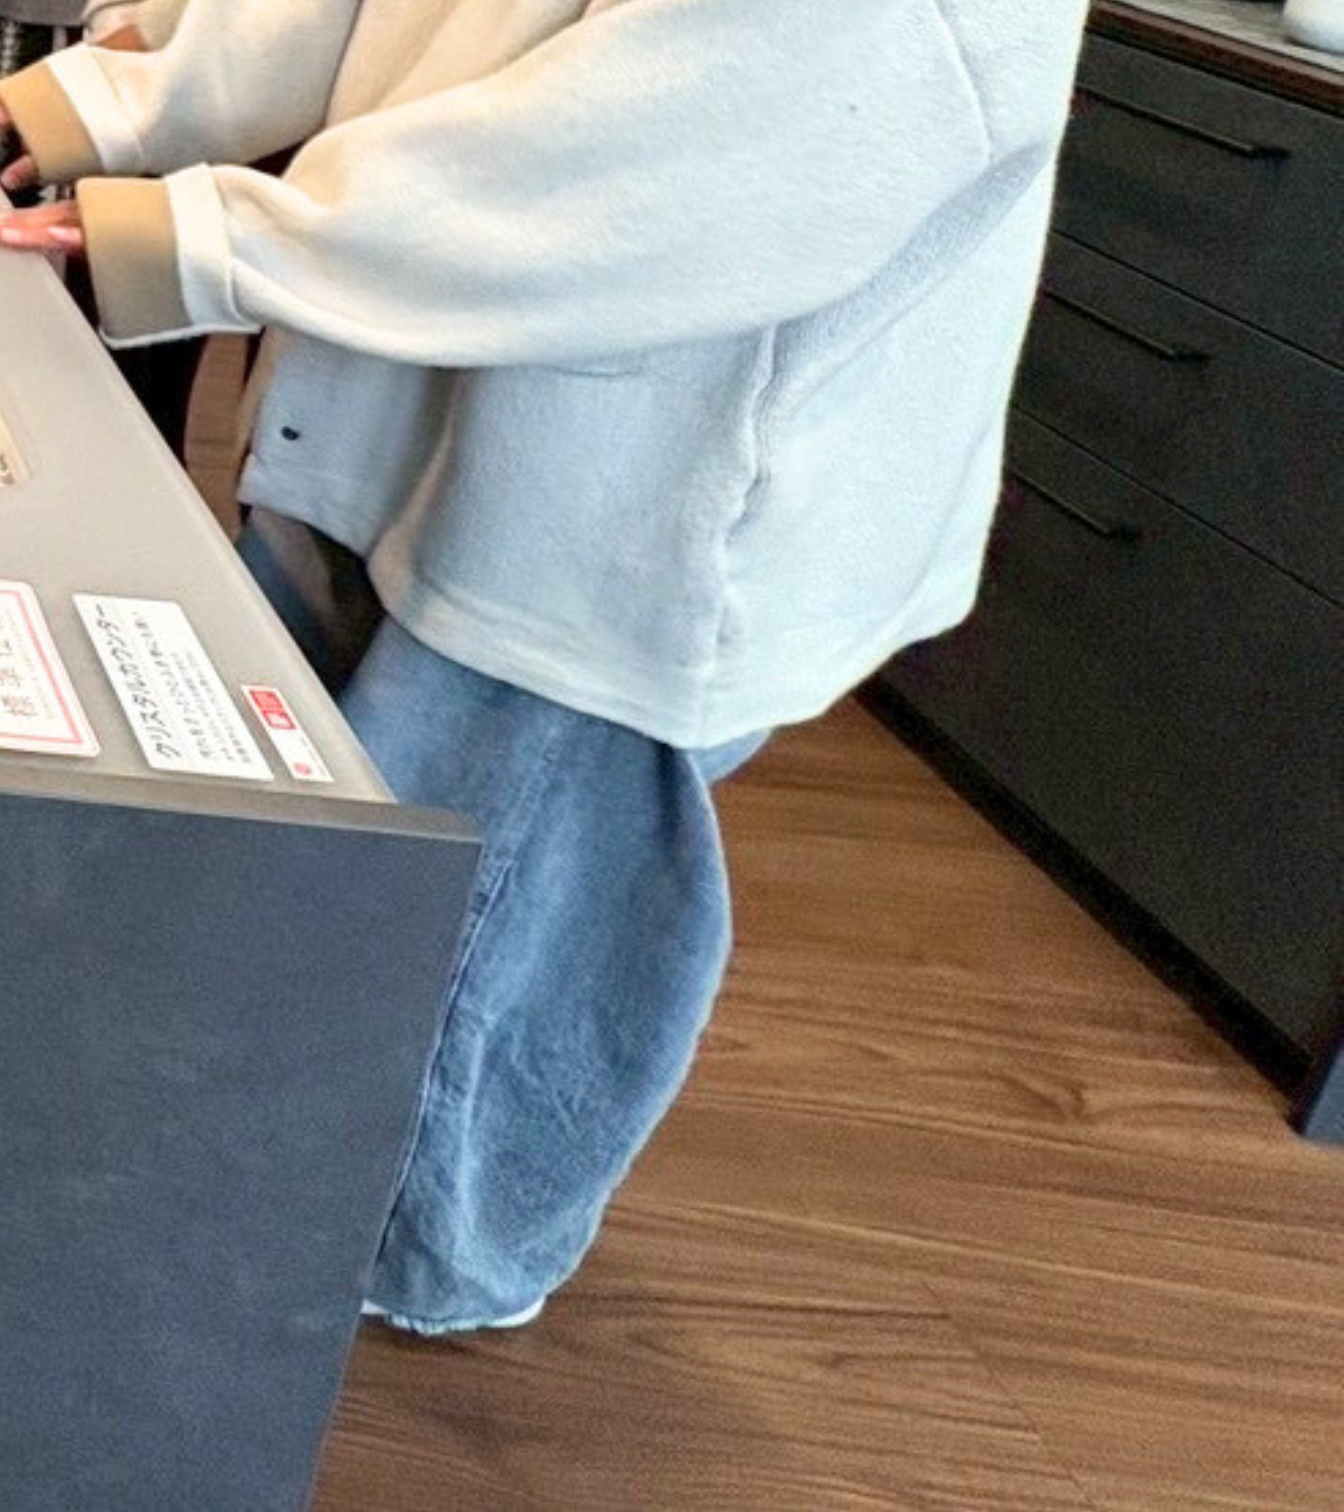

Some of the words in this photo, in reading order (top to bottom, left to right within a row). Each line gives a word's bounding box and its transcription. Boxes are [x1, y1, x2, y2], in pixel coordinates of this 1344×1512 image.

[94, 602, 182, 760] クリスタルカウンター
